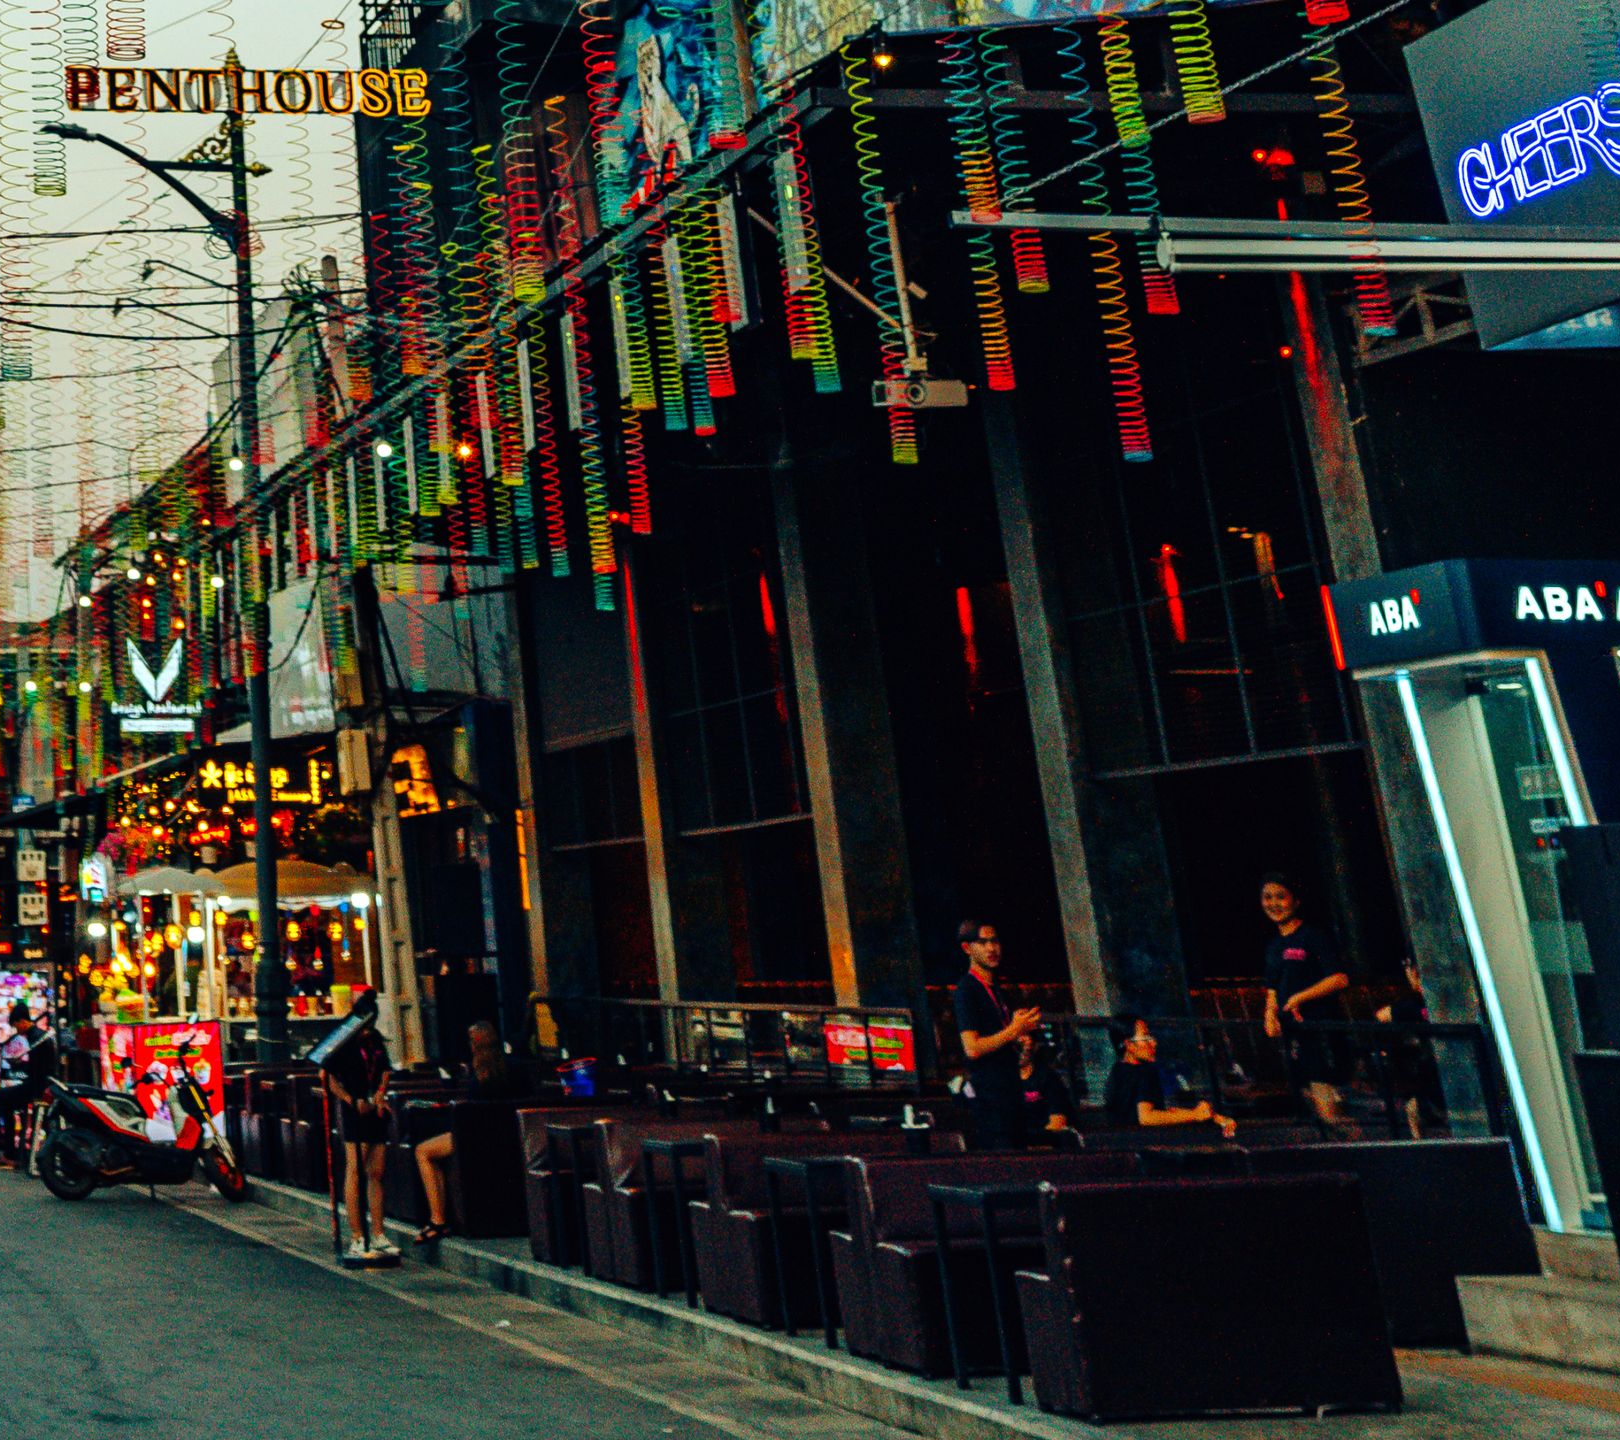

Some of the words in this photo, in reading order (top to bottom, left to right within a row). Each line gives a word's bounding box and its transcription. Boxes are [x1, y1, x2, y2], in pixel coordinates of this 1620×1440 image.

[64, 66, 432, 117] PENTHOUSE
[1370, 594, 1421, 636] ABA
[1517, 586, 1603, 621] ABA
